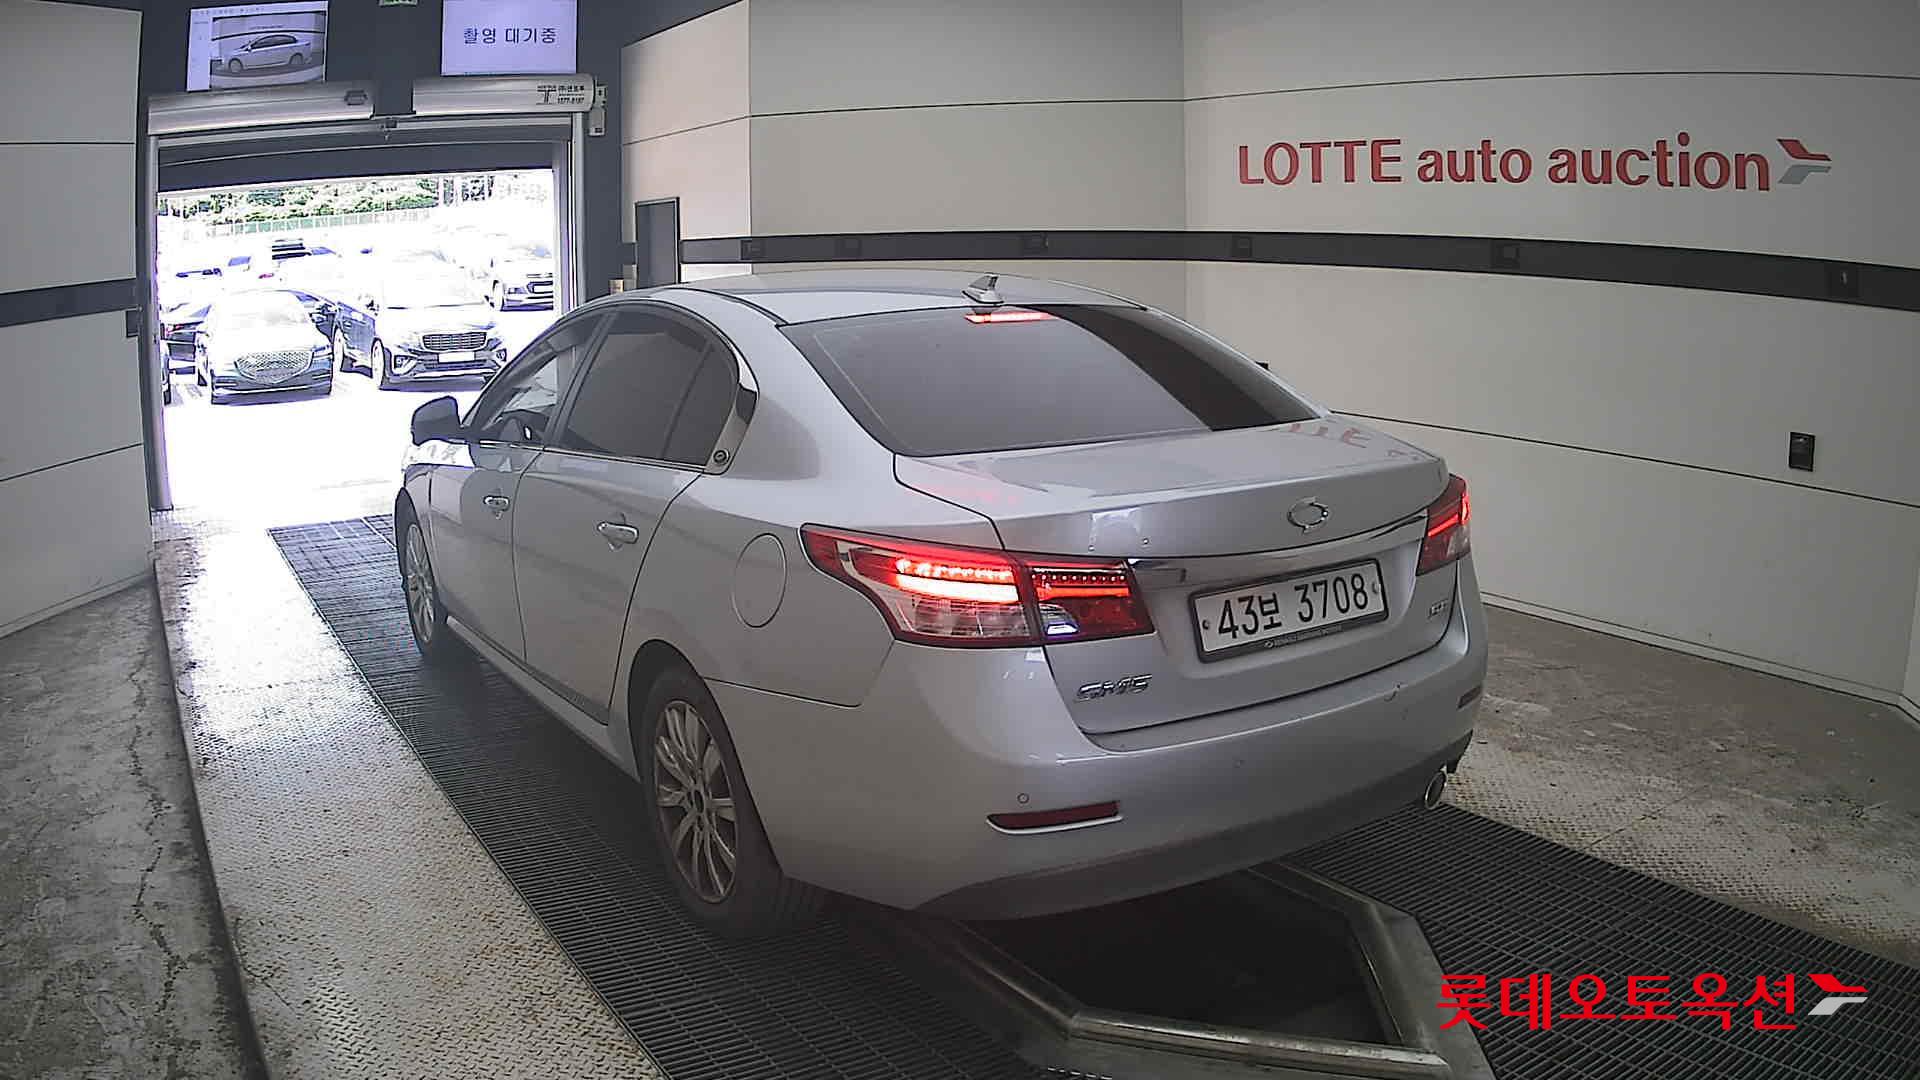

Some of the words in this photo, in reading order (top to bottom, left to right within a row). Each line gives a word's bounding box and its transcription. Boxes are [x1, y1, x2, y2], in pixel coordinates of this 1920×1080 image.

[464, 27, 496, 44] 촬영
[505, 27, 557, 44] 대기중
[1238, 138, 1402, 186] LOTTE
[1416, 139, 1533, 185] auto
[1547, 131, 1771, 192] auction
[1217, 592, 1283, 640] 43보
[1293, 572, 1369, 623] 3708
